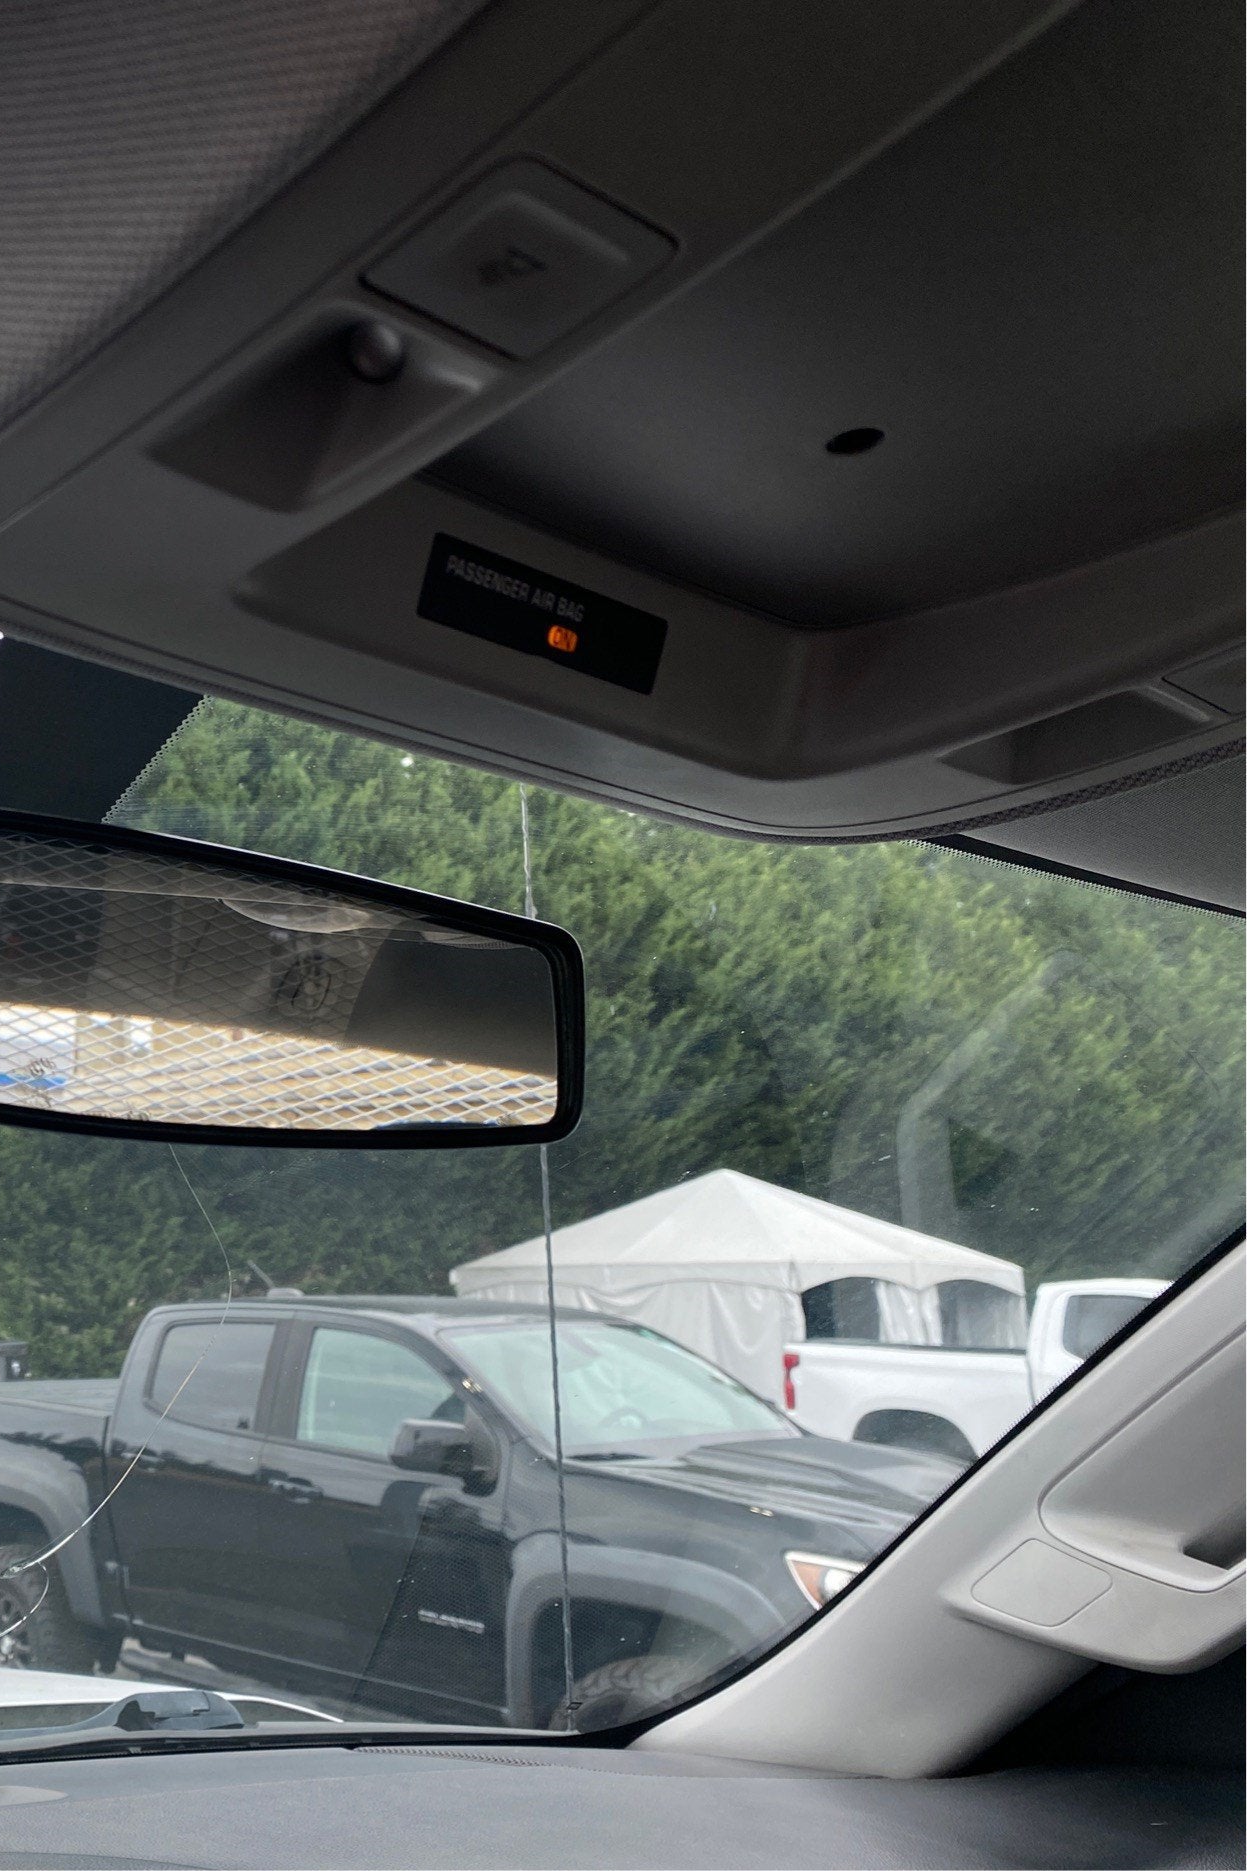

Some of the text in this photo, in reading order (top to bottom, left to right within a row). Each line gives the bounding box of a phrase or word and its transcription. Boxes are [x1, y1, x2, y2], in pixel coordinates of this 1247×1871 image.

[446, 554, 586, 623] PASSENGER AIR BAG
[551, 625, 576, 651] ON
